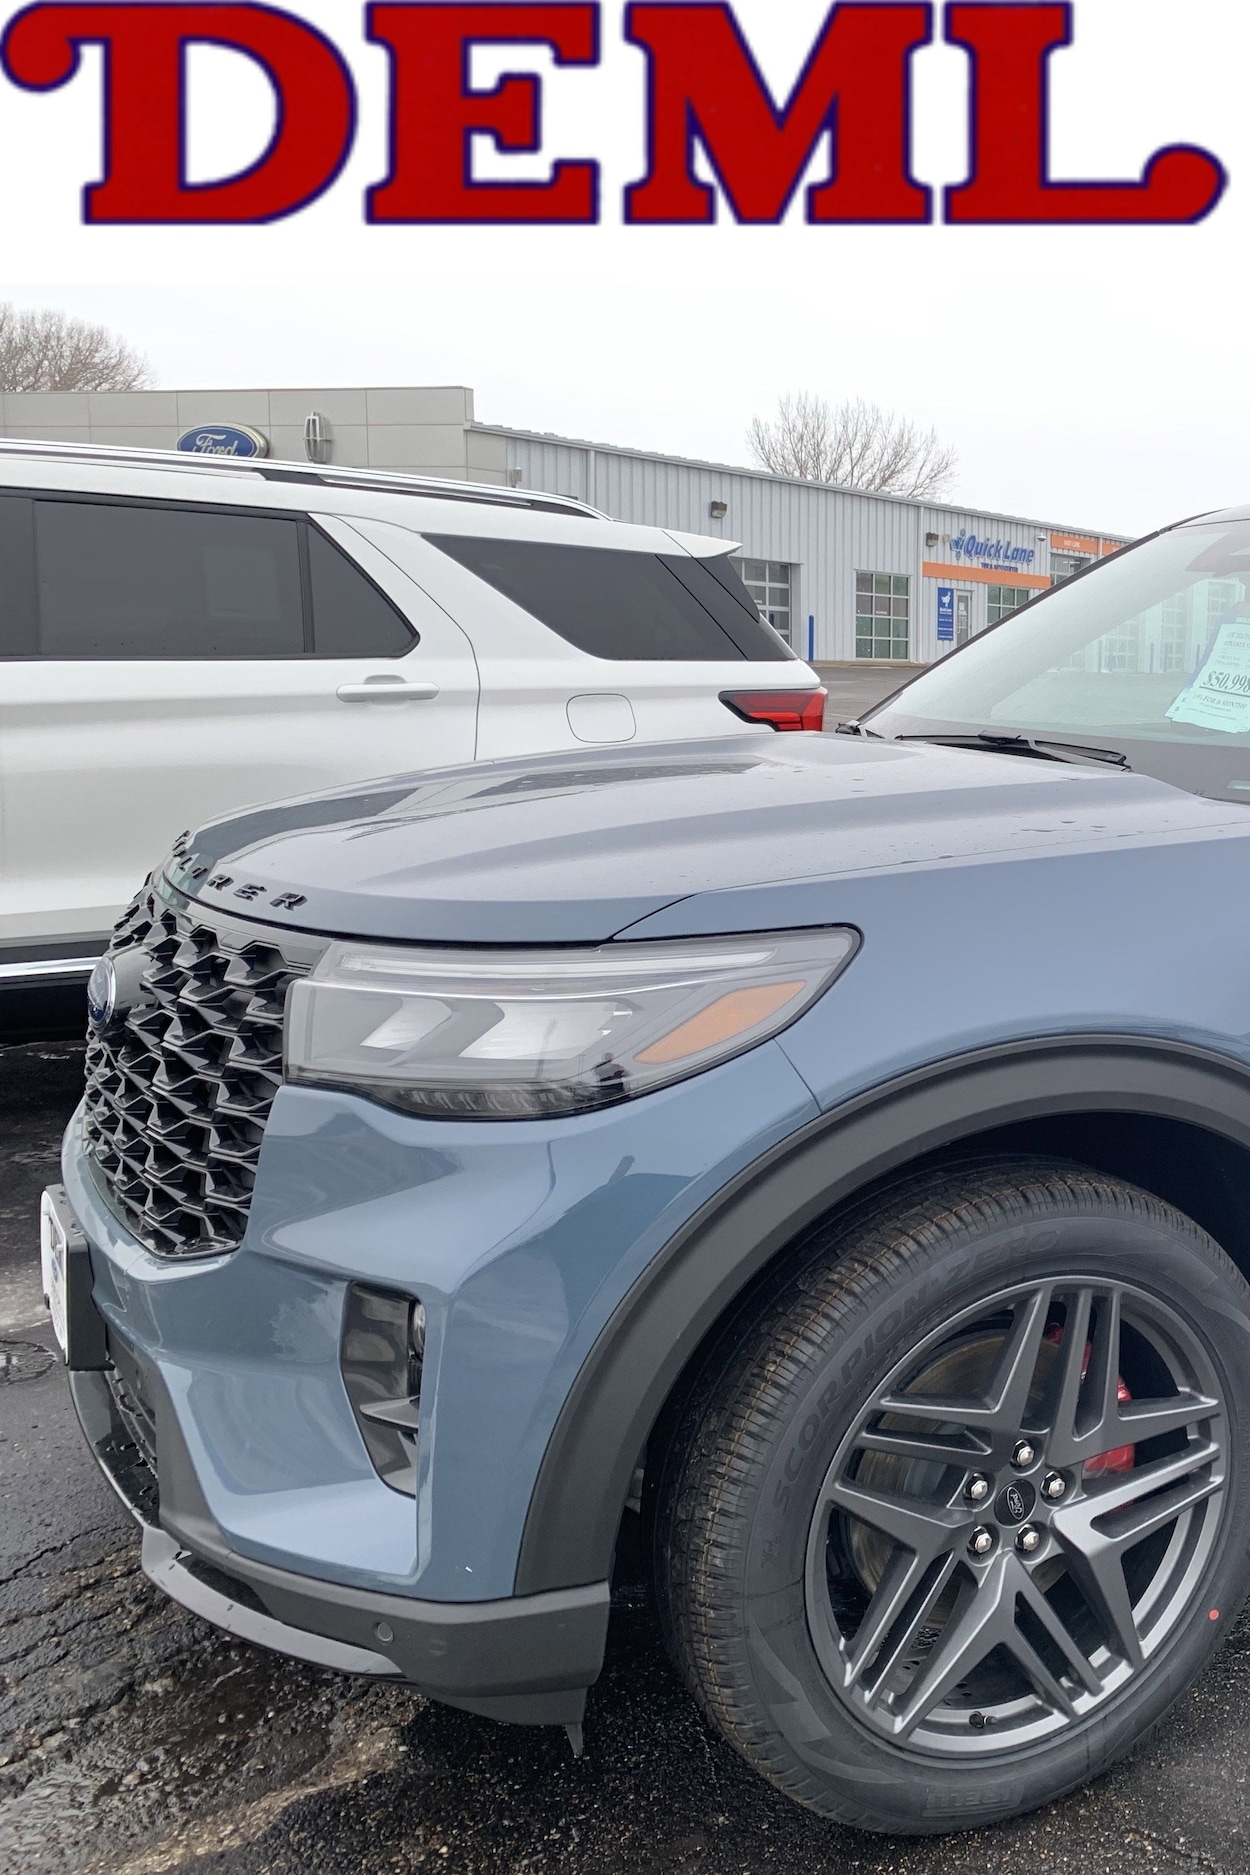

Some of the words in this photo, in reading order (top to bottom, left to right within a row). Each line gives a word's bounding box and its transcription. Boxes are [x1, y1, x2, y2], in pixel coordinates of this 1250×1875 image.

[192, 433, 239, 457] Ford
[964, 534, 1002, 560] Quick
[1003, 540, 1035, 564] Lane
[772, 1288, 927, 1515] SCORPION
[947, 1229, 1061, 1282] ZERO
